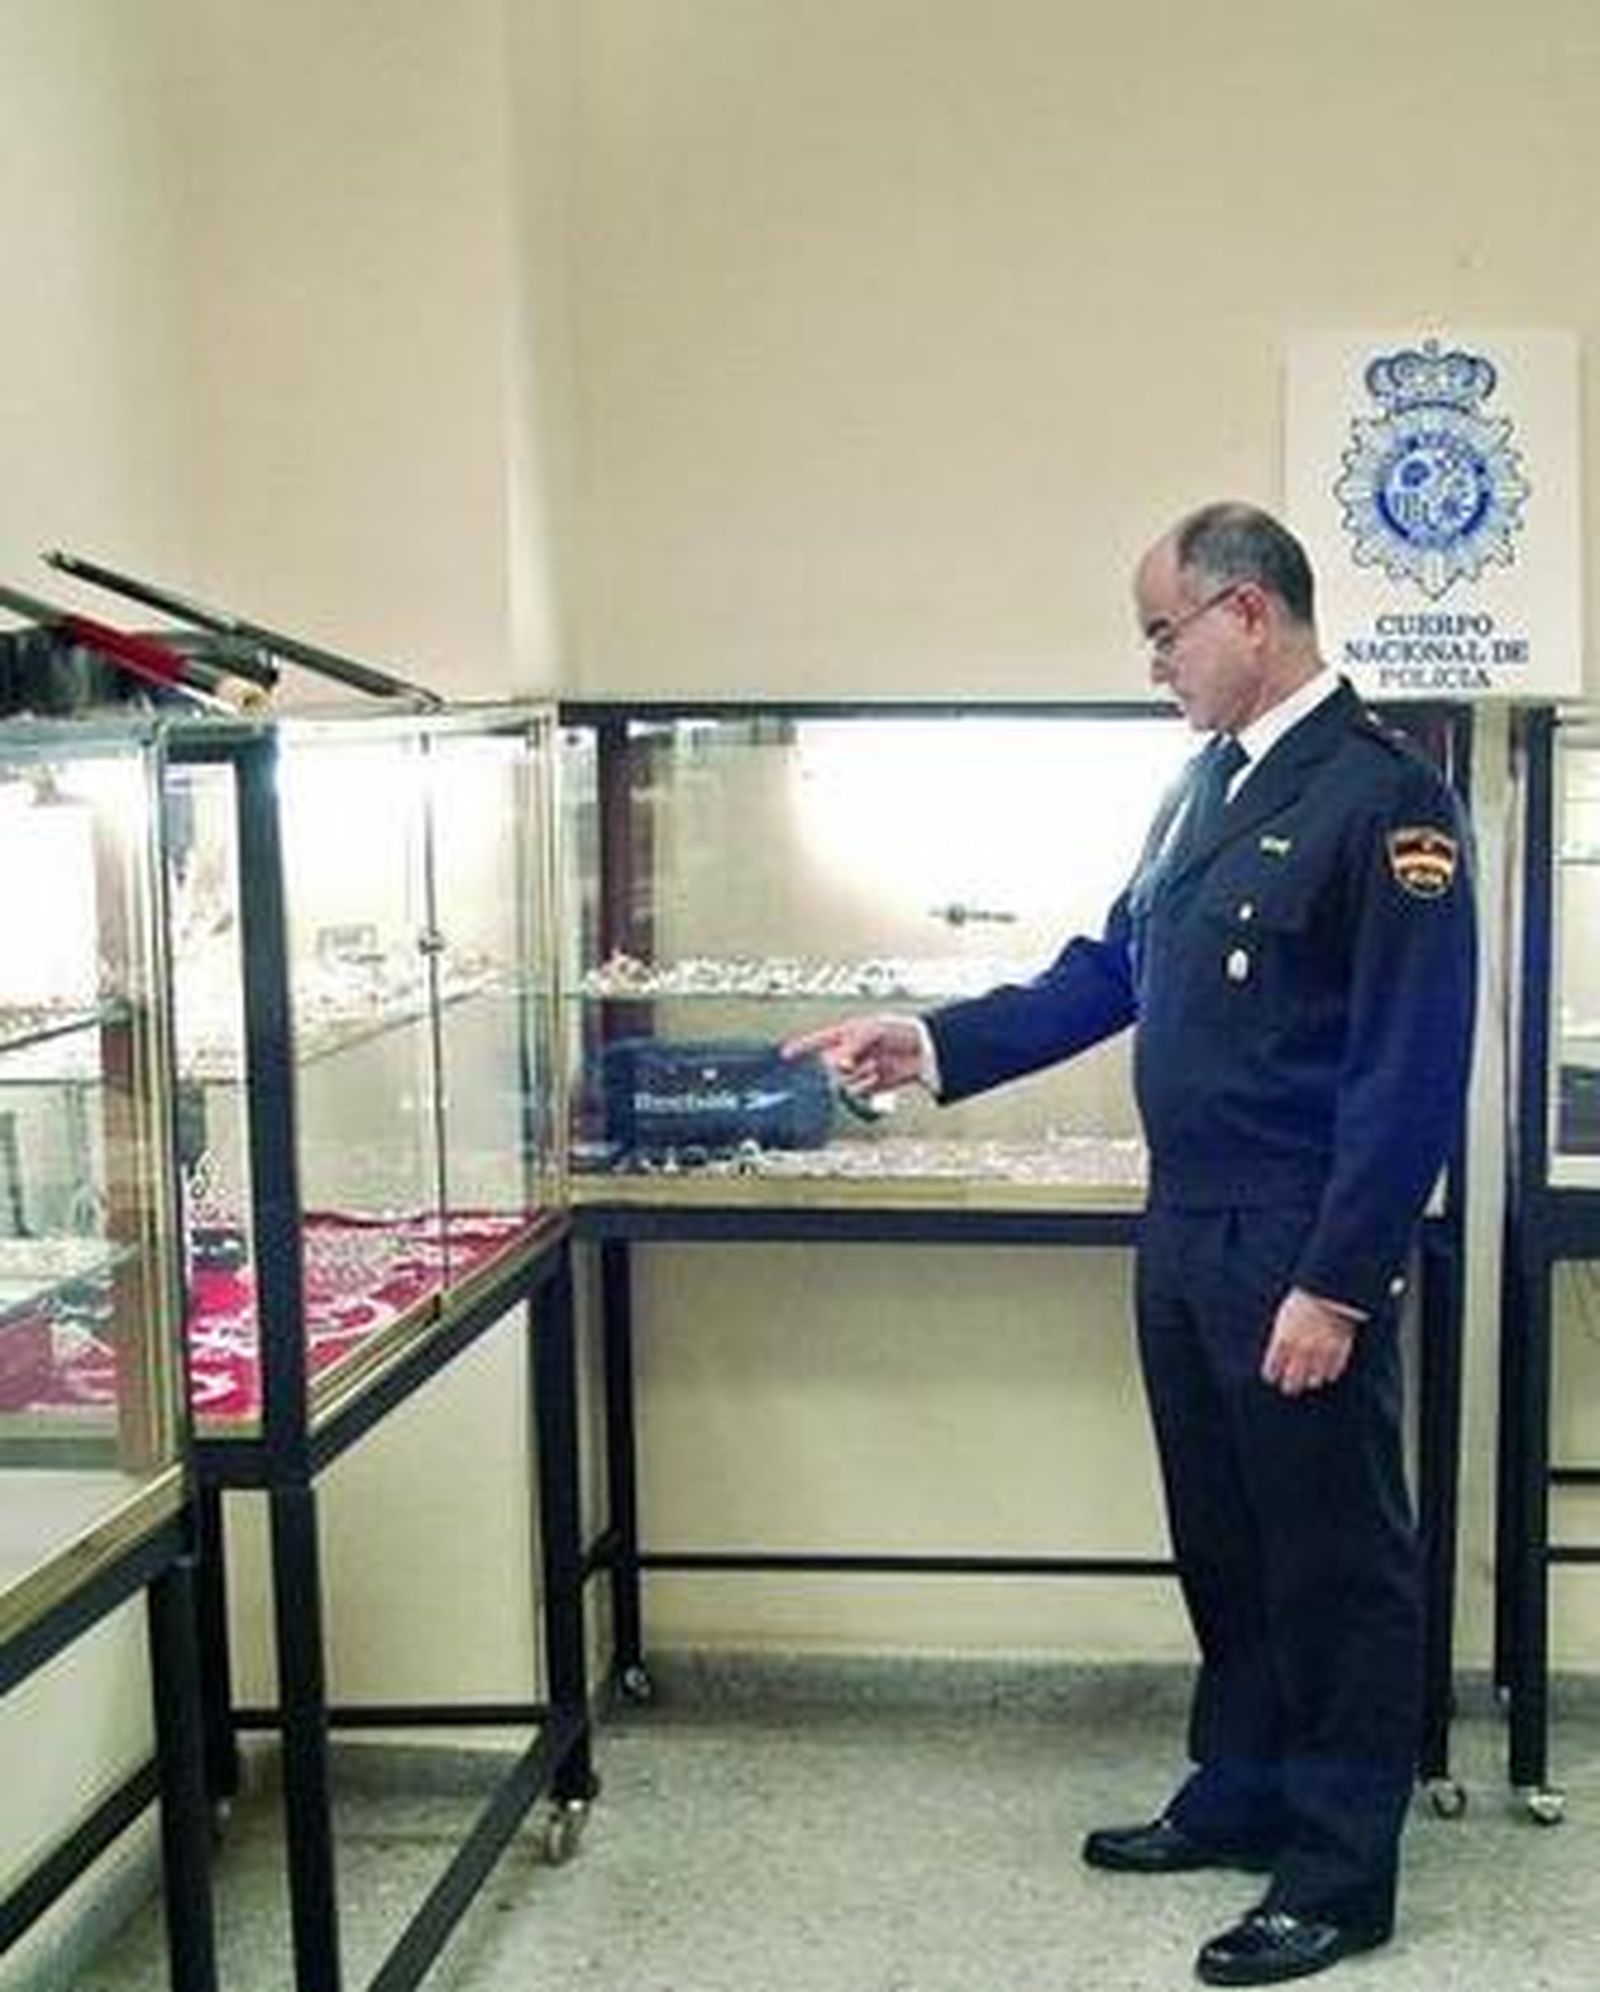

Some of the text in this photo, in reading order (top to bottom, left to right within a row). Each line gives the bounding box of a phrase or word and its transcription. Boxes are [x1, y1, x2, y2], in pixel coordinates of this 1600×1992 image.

[1375, 613, 1493, 636] CUERPO
[1343, 639, 1529, 664] NACIONAL DE
